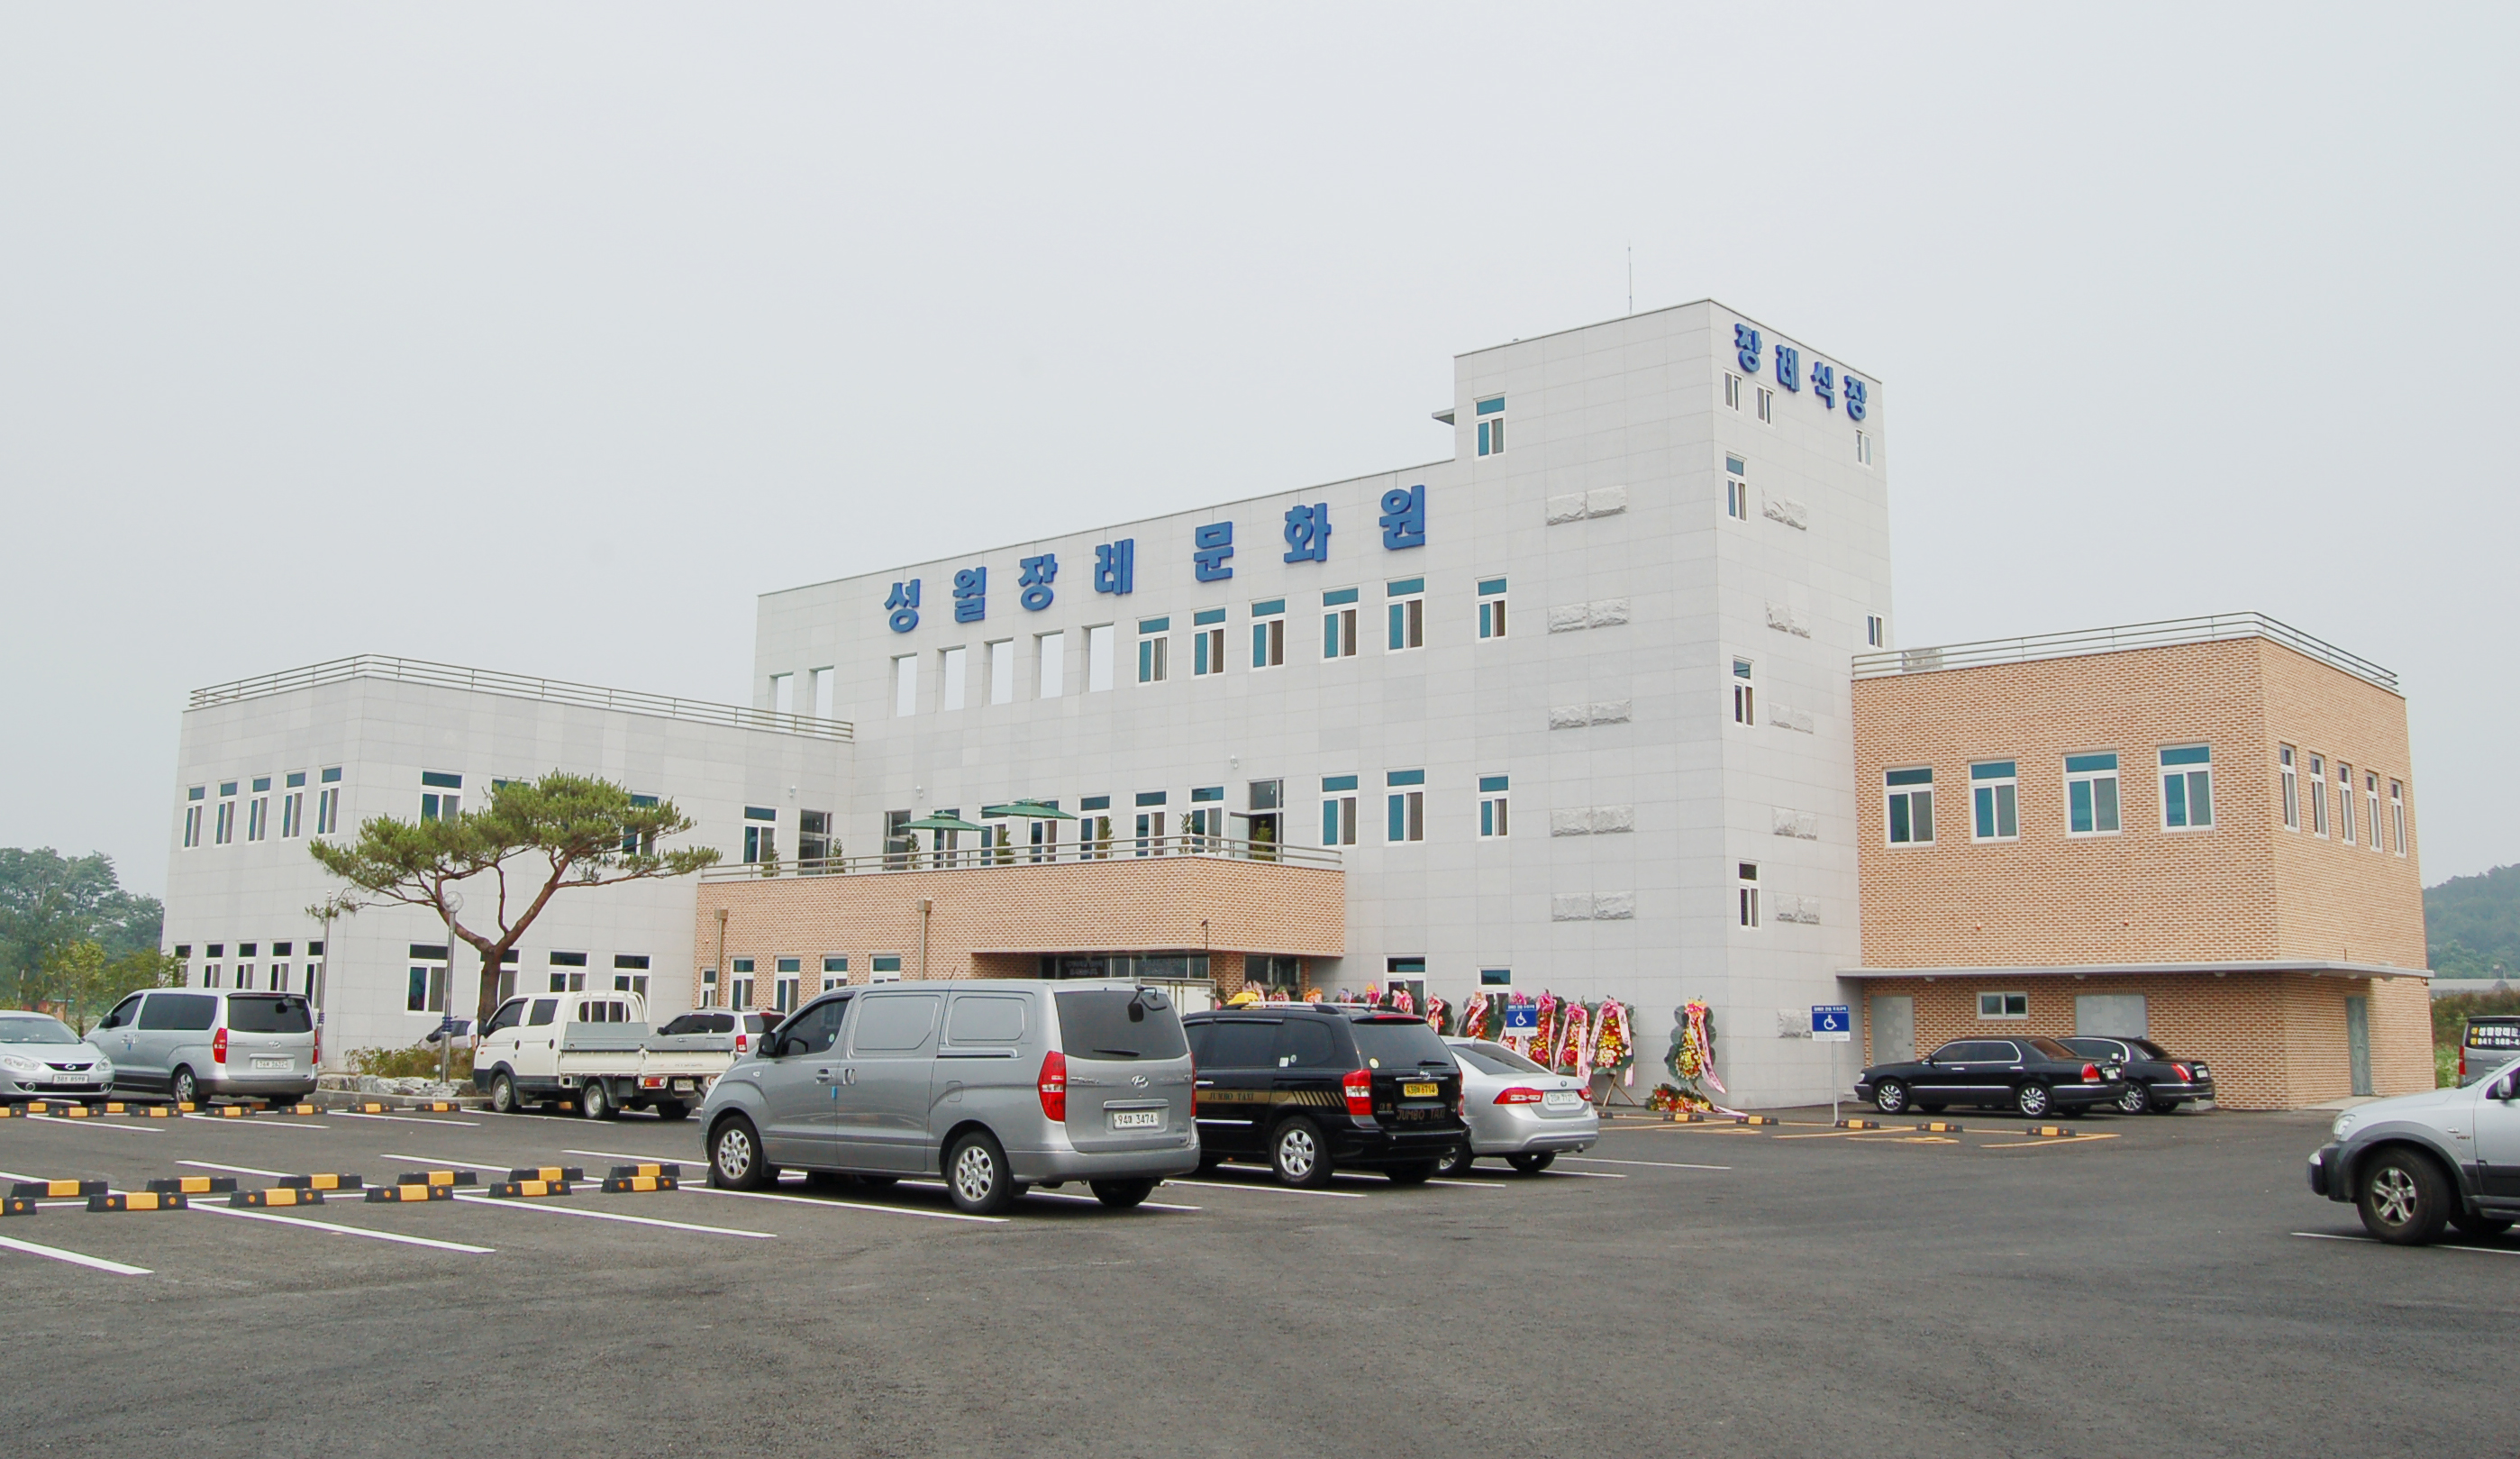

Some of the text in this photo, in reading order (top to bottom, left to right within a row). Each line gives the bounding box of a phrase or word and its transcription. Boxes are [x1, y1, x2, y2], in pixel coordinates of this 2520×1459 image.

[1734, 323, 1868, 421] 장례식장
[1209, 1092, 1254, 1101] JUMBO TAXI
[1136, 1113, 1155, 1125] 3474
[1396, 1109, 1424, 1121] JUMBO
[1430, 1108, 1446, 1119] TAXI
